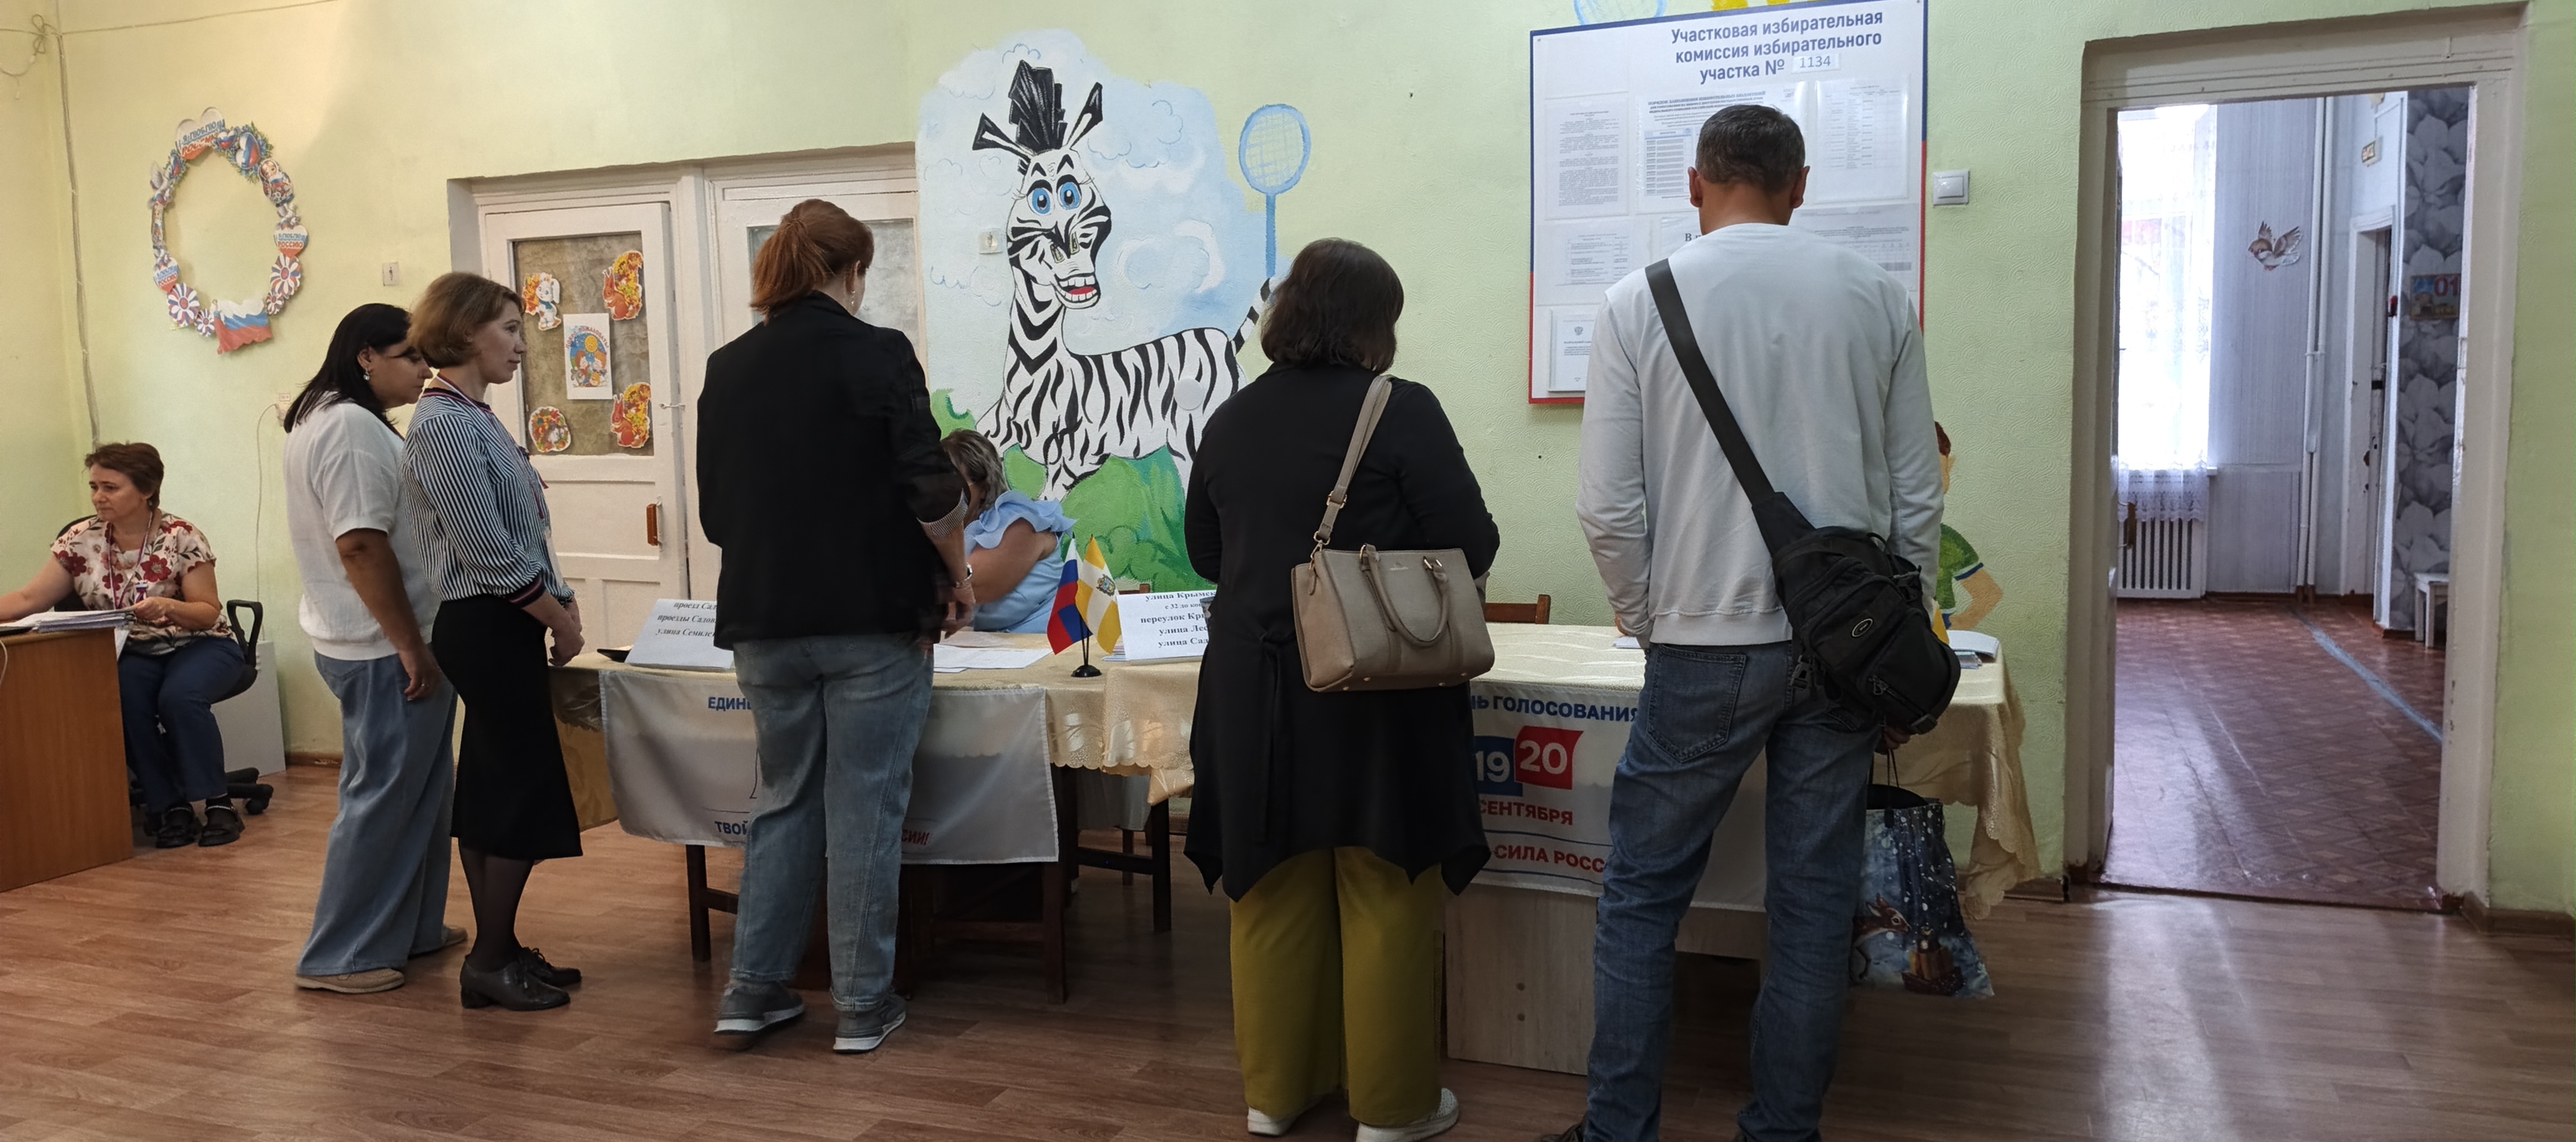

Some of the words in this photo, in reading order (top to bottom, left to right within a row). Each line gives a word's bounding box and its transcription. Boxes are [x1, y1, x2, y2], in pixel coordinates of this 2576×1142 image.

[1671, 24, 1758, 44] Участковая
[1762, 12, 1883, 35] избирательная
[1675, 43, 1749, 63] комиссия
[1753, 32, 1882, 56] избирательного
[1700, 64, 1760, 85] участка
[1765, 58, 1785, 76] №
[1799, 56, 1831, 68] 1134
[1145, 593, 1174, 602] улица
[1140, 615, 1186, 624] переулок
[1159, 627, 1188, 636] улица
[1158, 639, 1187, 648] улица
[1475, 750, 1511, 784] 19
[1519, 739, 1568, 775] 20
[1494, 844, 1549, 863] СИЛА
